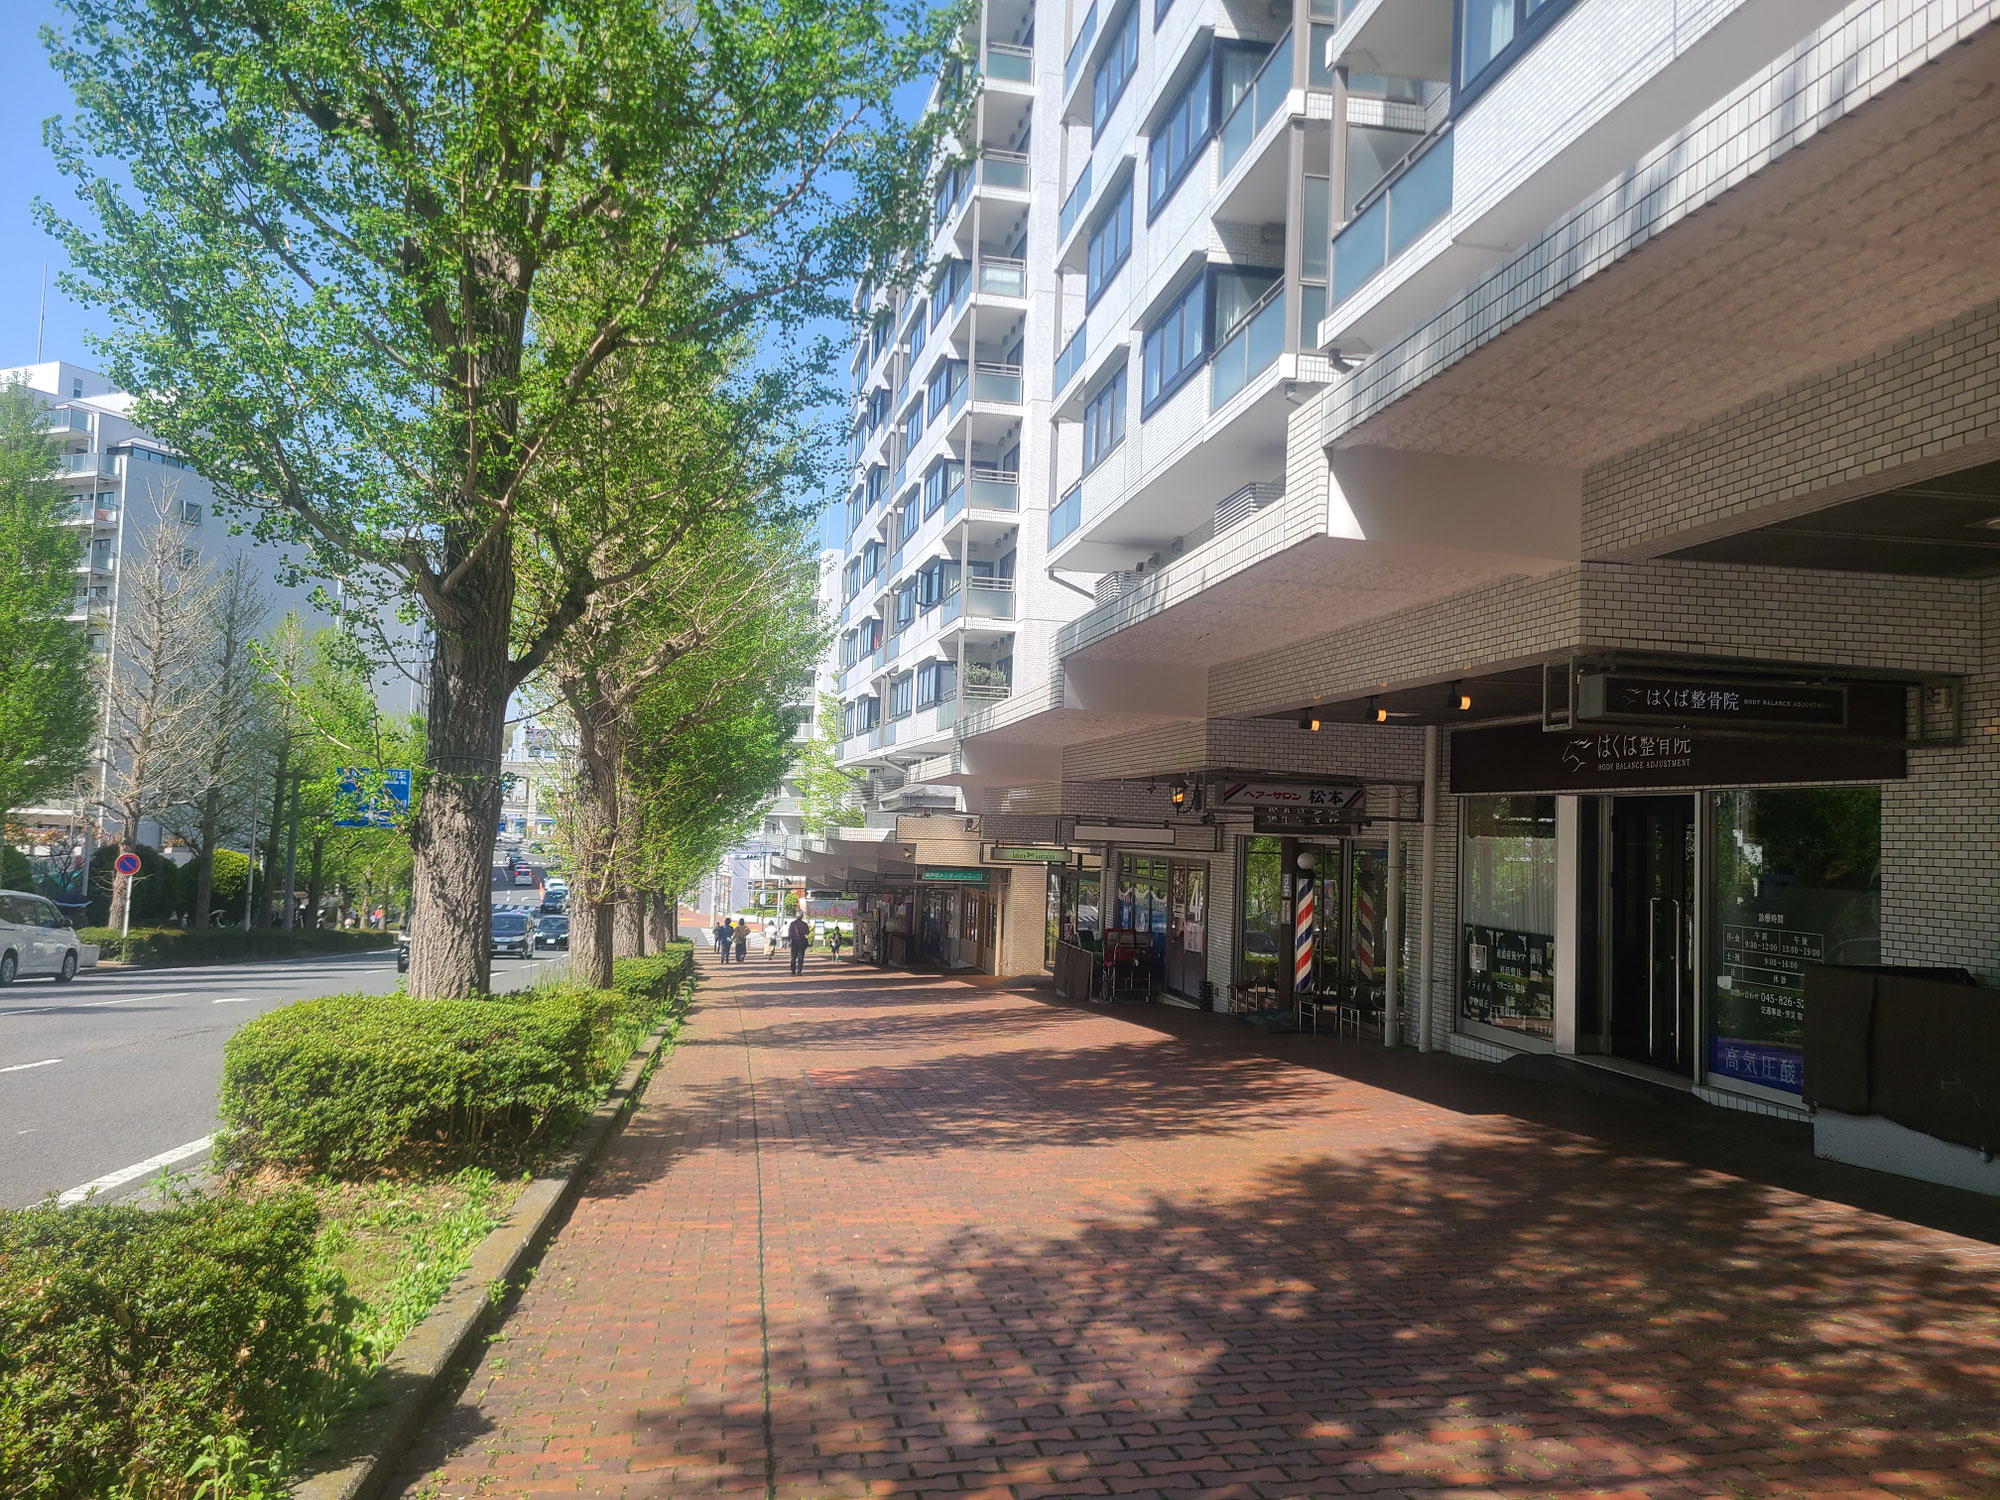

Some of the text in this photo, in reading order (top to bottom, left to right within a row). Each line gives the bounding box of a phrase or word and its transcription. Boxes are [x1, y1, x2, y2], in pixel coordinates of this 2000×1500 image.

[1646, 689, 1740, 711] はくば整骨院
[1743, 698, 1835, 711] BODY BALANCE ADJUSTME
[1597, 758, 1691, 772] BODY BALANCE ADJUSTMENT
[1244, 789, 1343, 806] ヘアーサロン 松本
[1725, 1046, 1803, 1087] 高気圧酸
